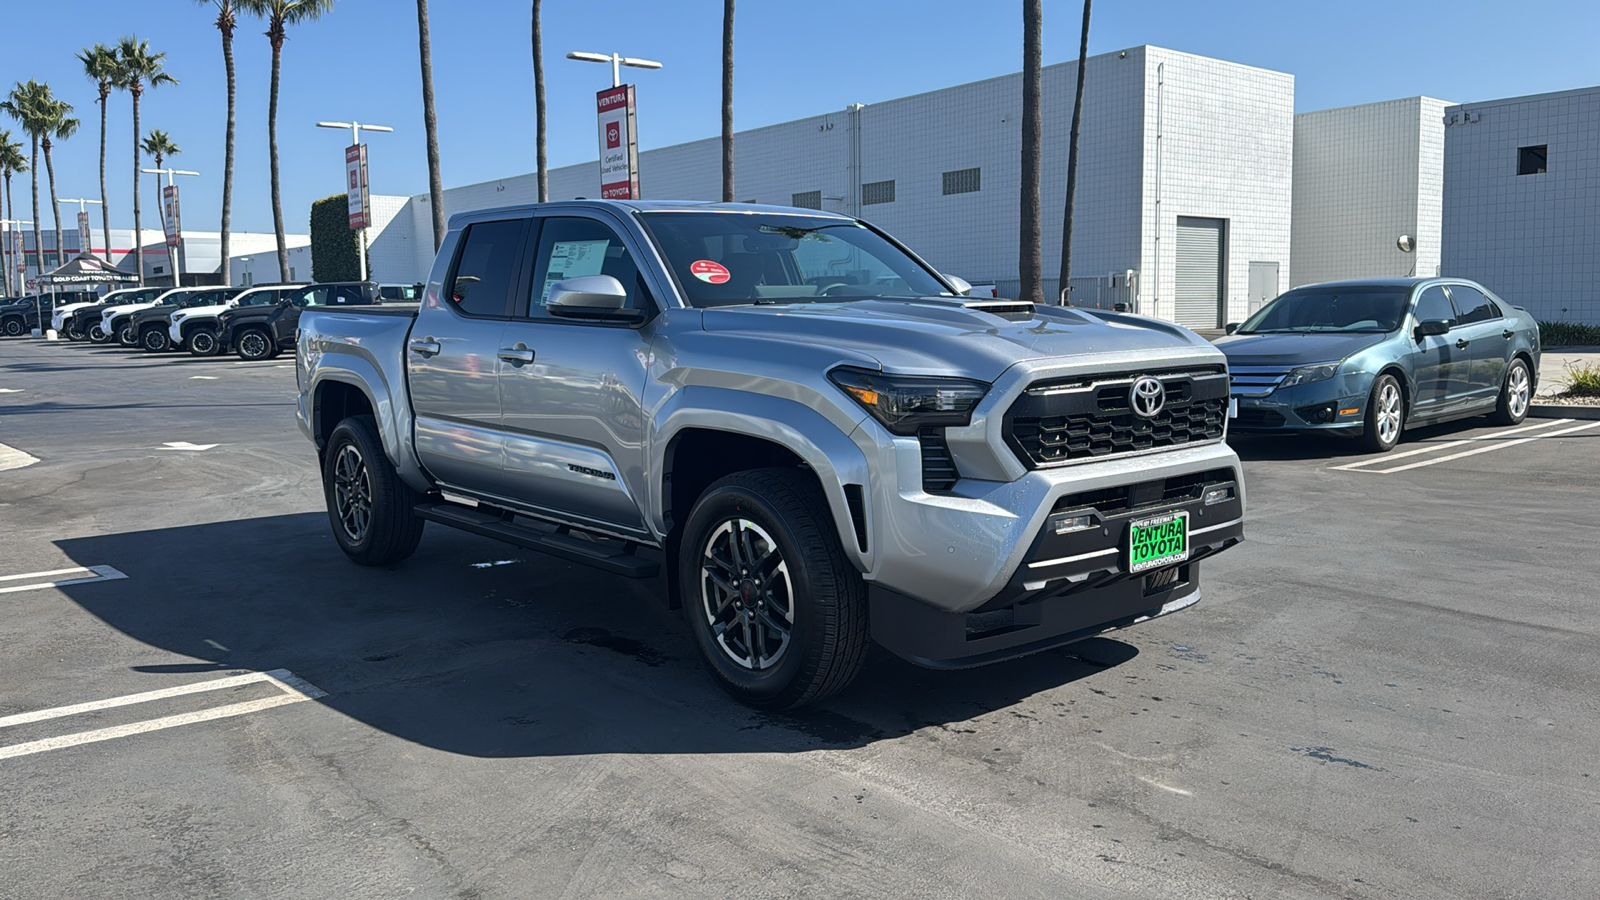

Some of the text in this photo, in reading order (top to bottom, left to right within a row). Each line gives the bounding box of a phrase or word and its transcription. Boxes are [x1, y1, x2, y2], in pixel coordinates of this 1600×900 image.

[598, 93, 626, 107] VENTURA
[605, 153, 623, 163] Certified
[609, 188, 629, 197] TOYOTA
[567, 463, 616, 480] TACOMA
[1132, 521, 1182, 545] VENTURA
[1133, 537, 1181, 560] TOYOTA
